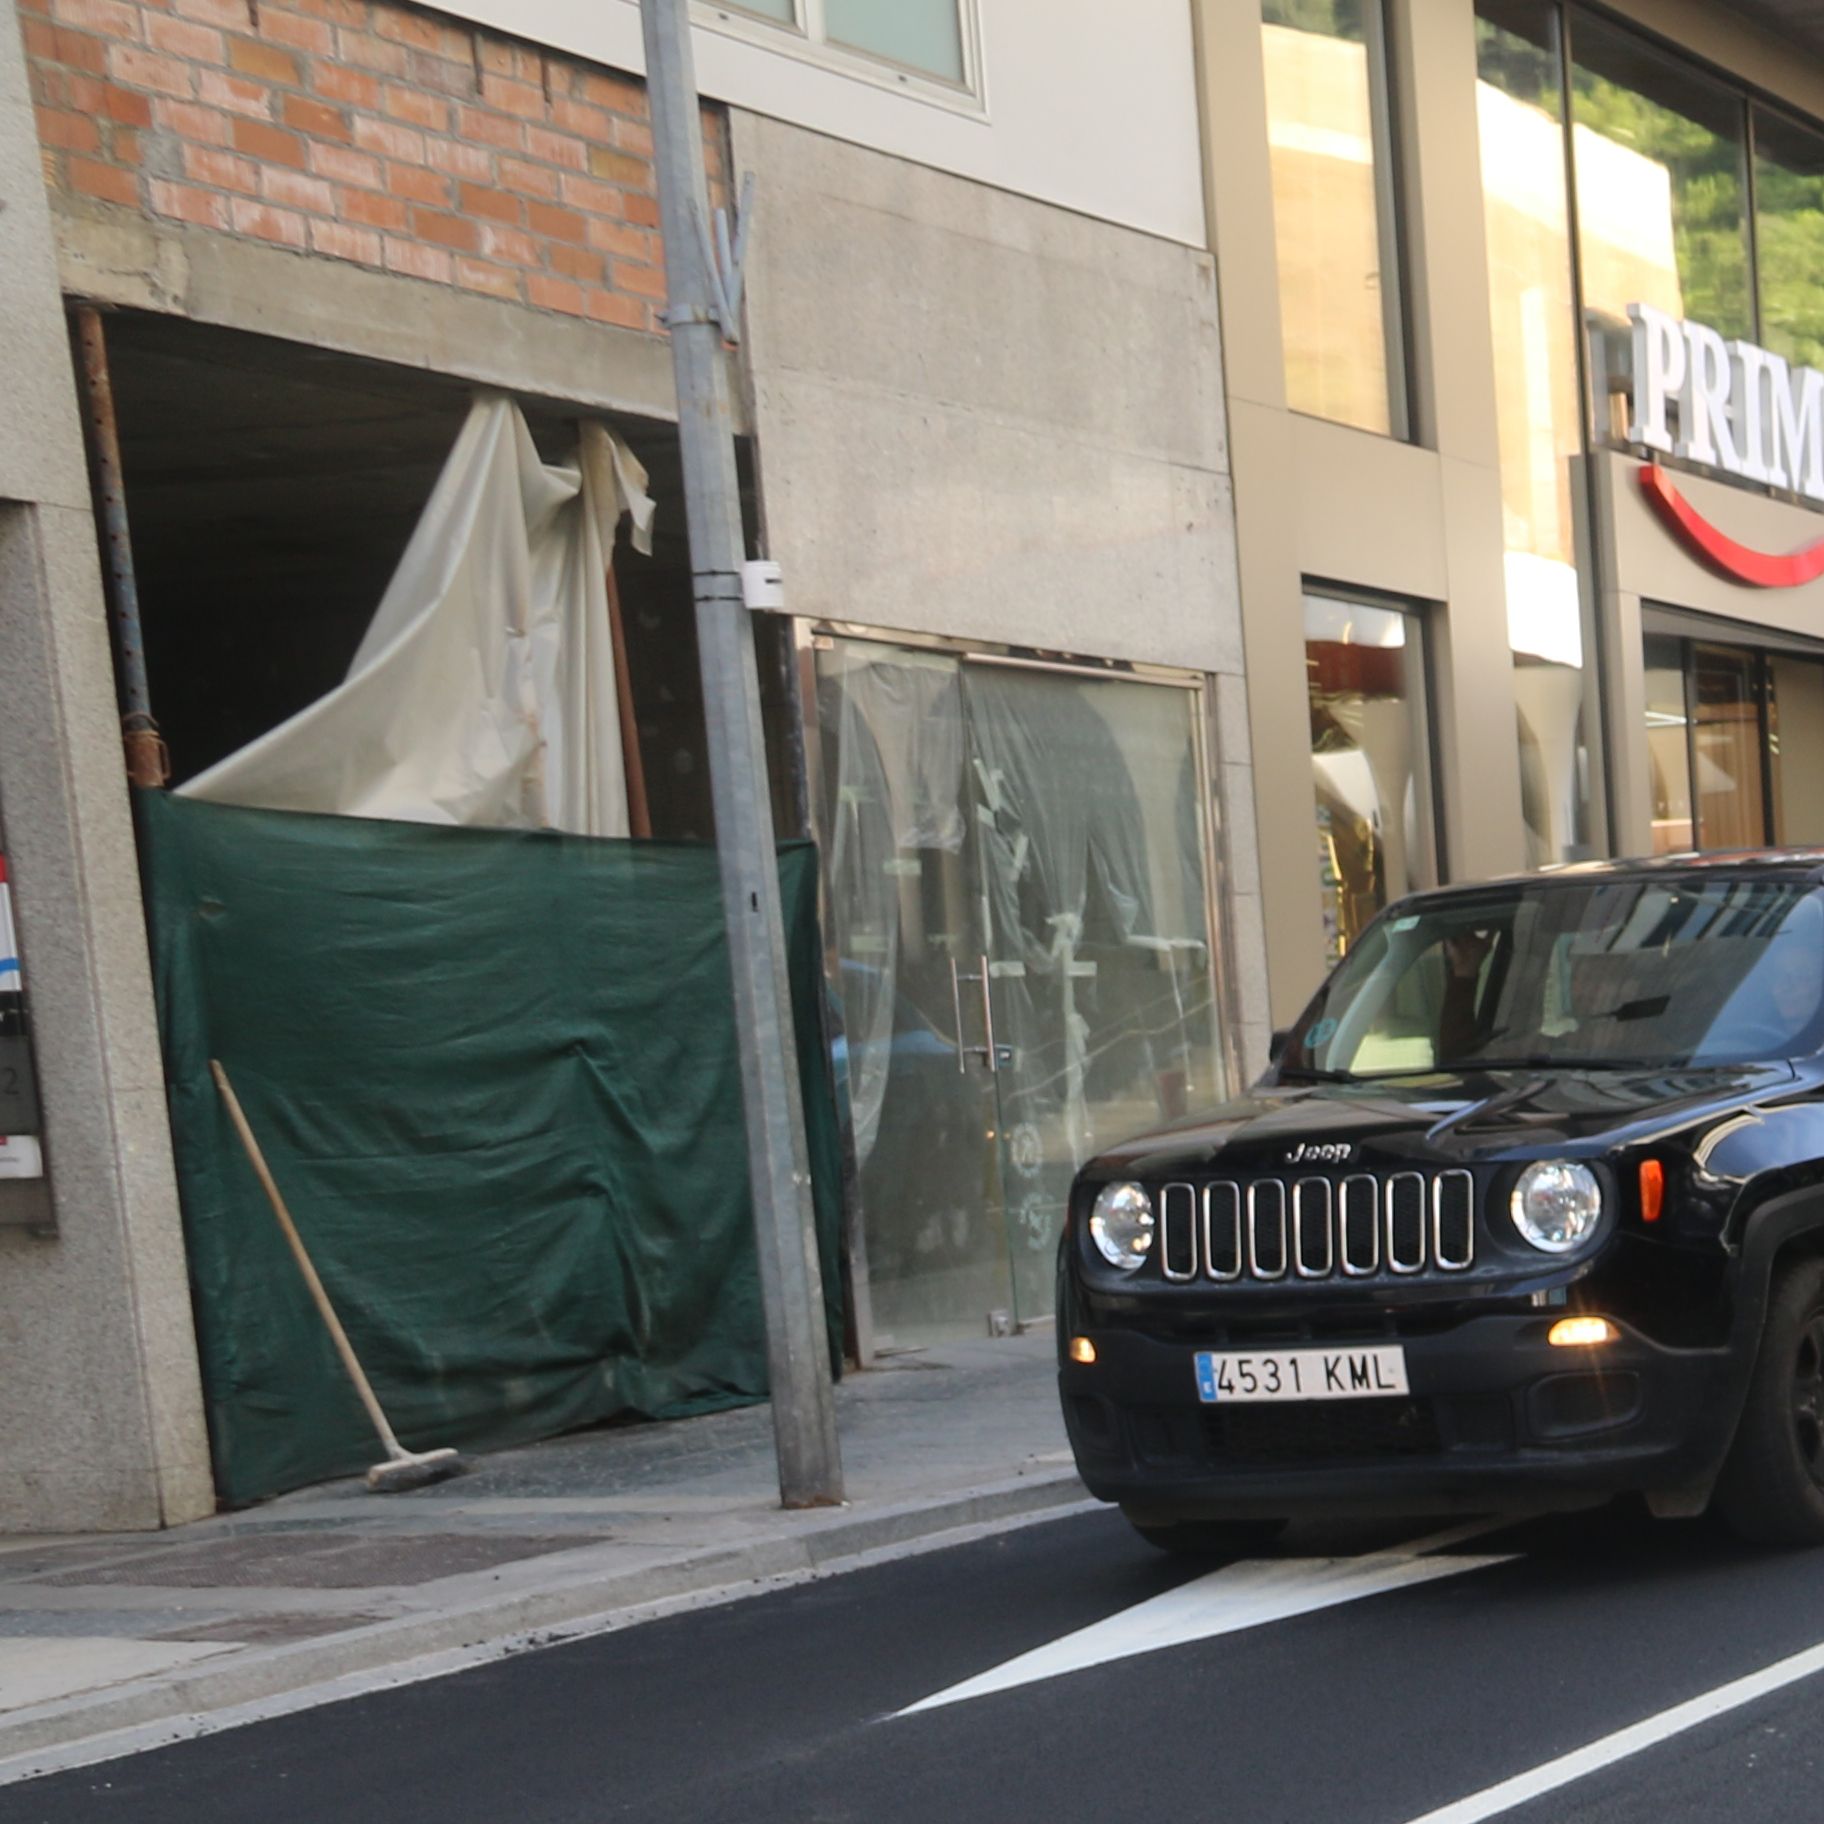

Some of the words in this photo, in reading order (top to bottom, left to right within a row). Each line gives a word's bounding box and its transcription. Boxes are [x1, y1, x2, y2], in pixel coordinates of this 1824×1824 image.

[1286, 1142, 1352, 1163] Jeep
[1217, 1357, 1302, 1394] 4531
[1323, 1354, 1396, 1392] KML
